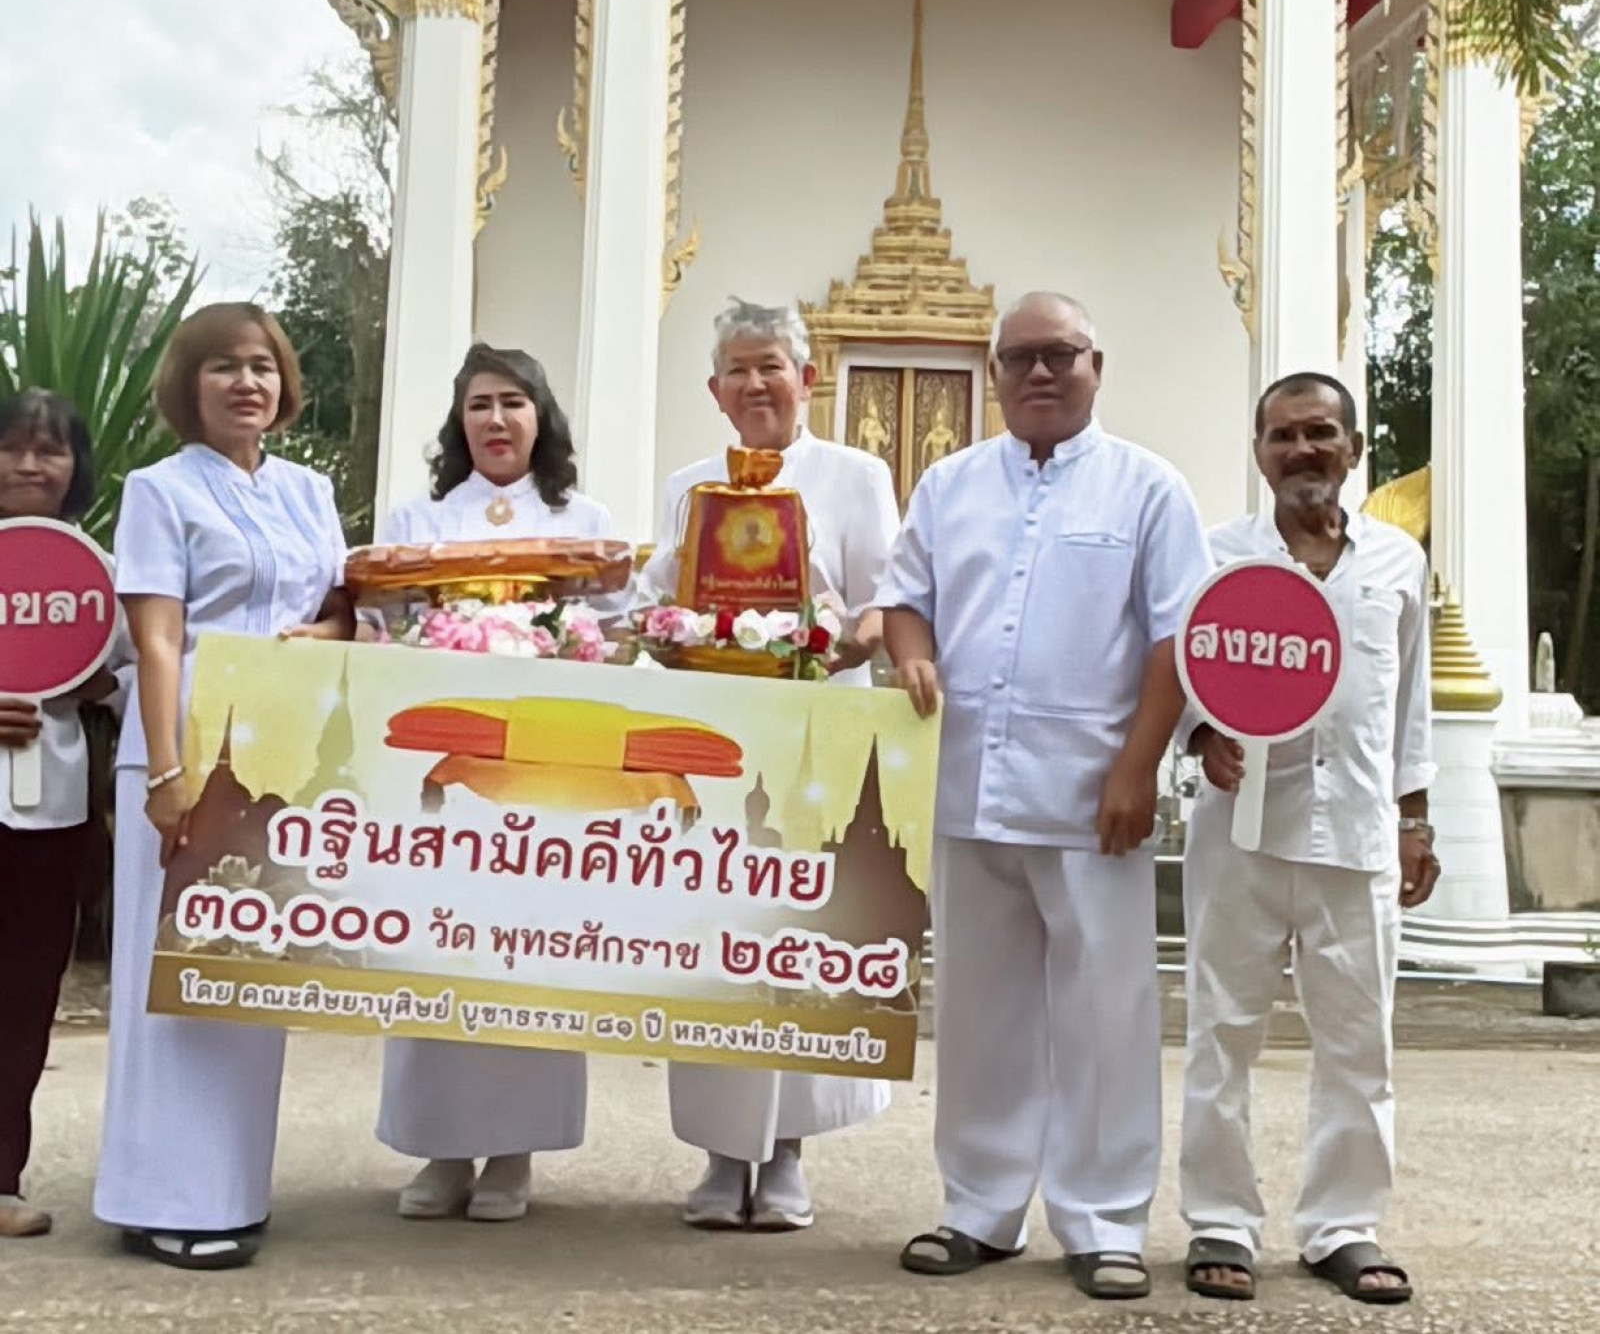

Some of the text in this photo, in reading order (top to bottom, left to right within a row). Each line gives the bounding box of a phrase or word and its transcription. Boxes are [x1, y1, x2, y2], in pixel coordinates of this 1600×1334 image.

[0, 589, 105, 625] ขลา
[1189, 622, 1333, 673] สงขลา
[276, 797, 827, 903] กฐินสามัคคีทั่วไทย
[184, 893, 901, 989] ๓๐,๐๐๐ วัด พุทธศักราช ๒๕๖๘
[182, 971, 884, 1059] โดย คณะศิษยานุศิษย์ บูชาธรรม ๘๑ ปี หลวงพ่อธัมมชโย
